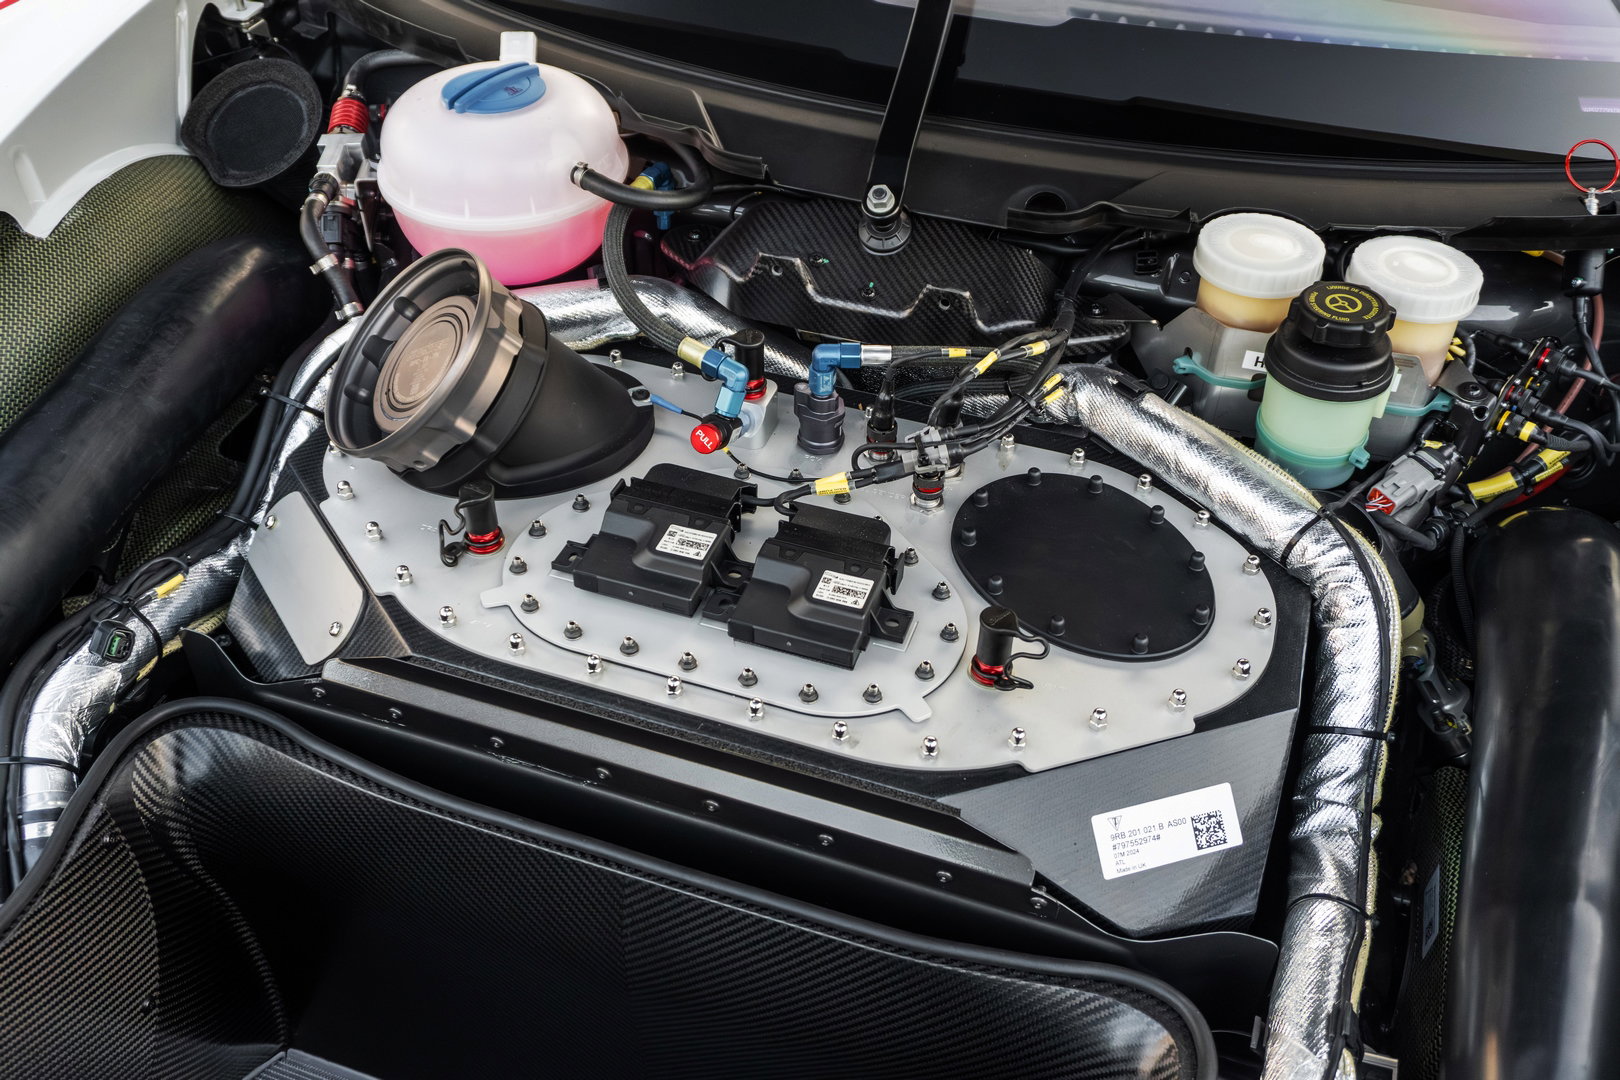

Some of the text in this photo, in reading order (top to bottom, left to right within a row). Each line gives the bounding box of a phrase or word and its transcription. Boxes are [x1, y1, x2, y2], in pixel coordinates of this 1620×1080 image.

[695, 429, 713, 450] PULL
[1110, 817, 1187, 841] 9RB 201 021 B AS00
[1112, 834, 1161, 850] #797552974#
